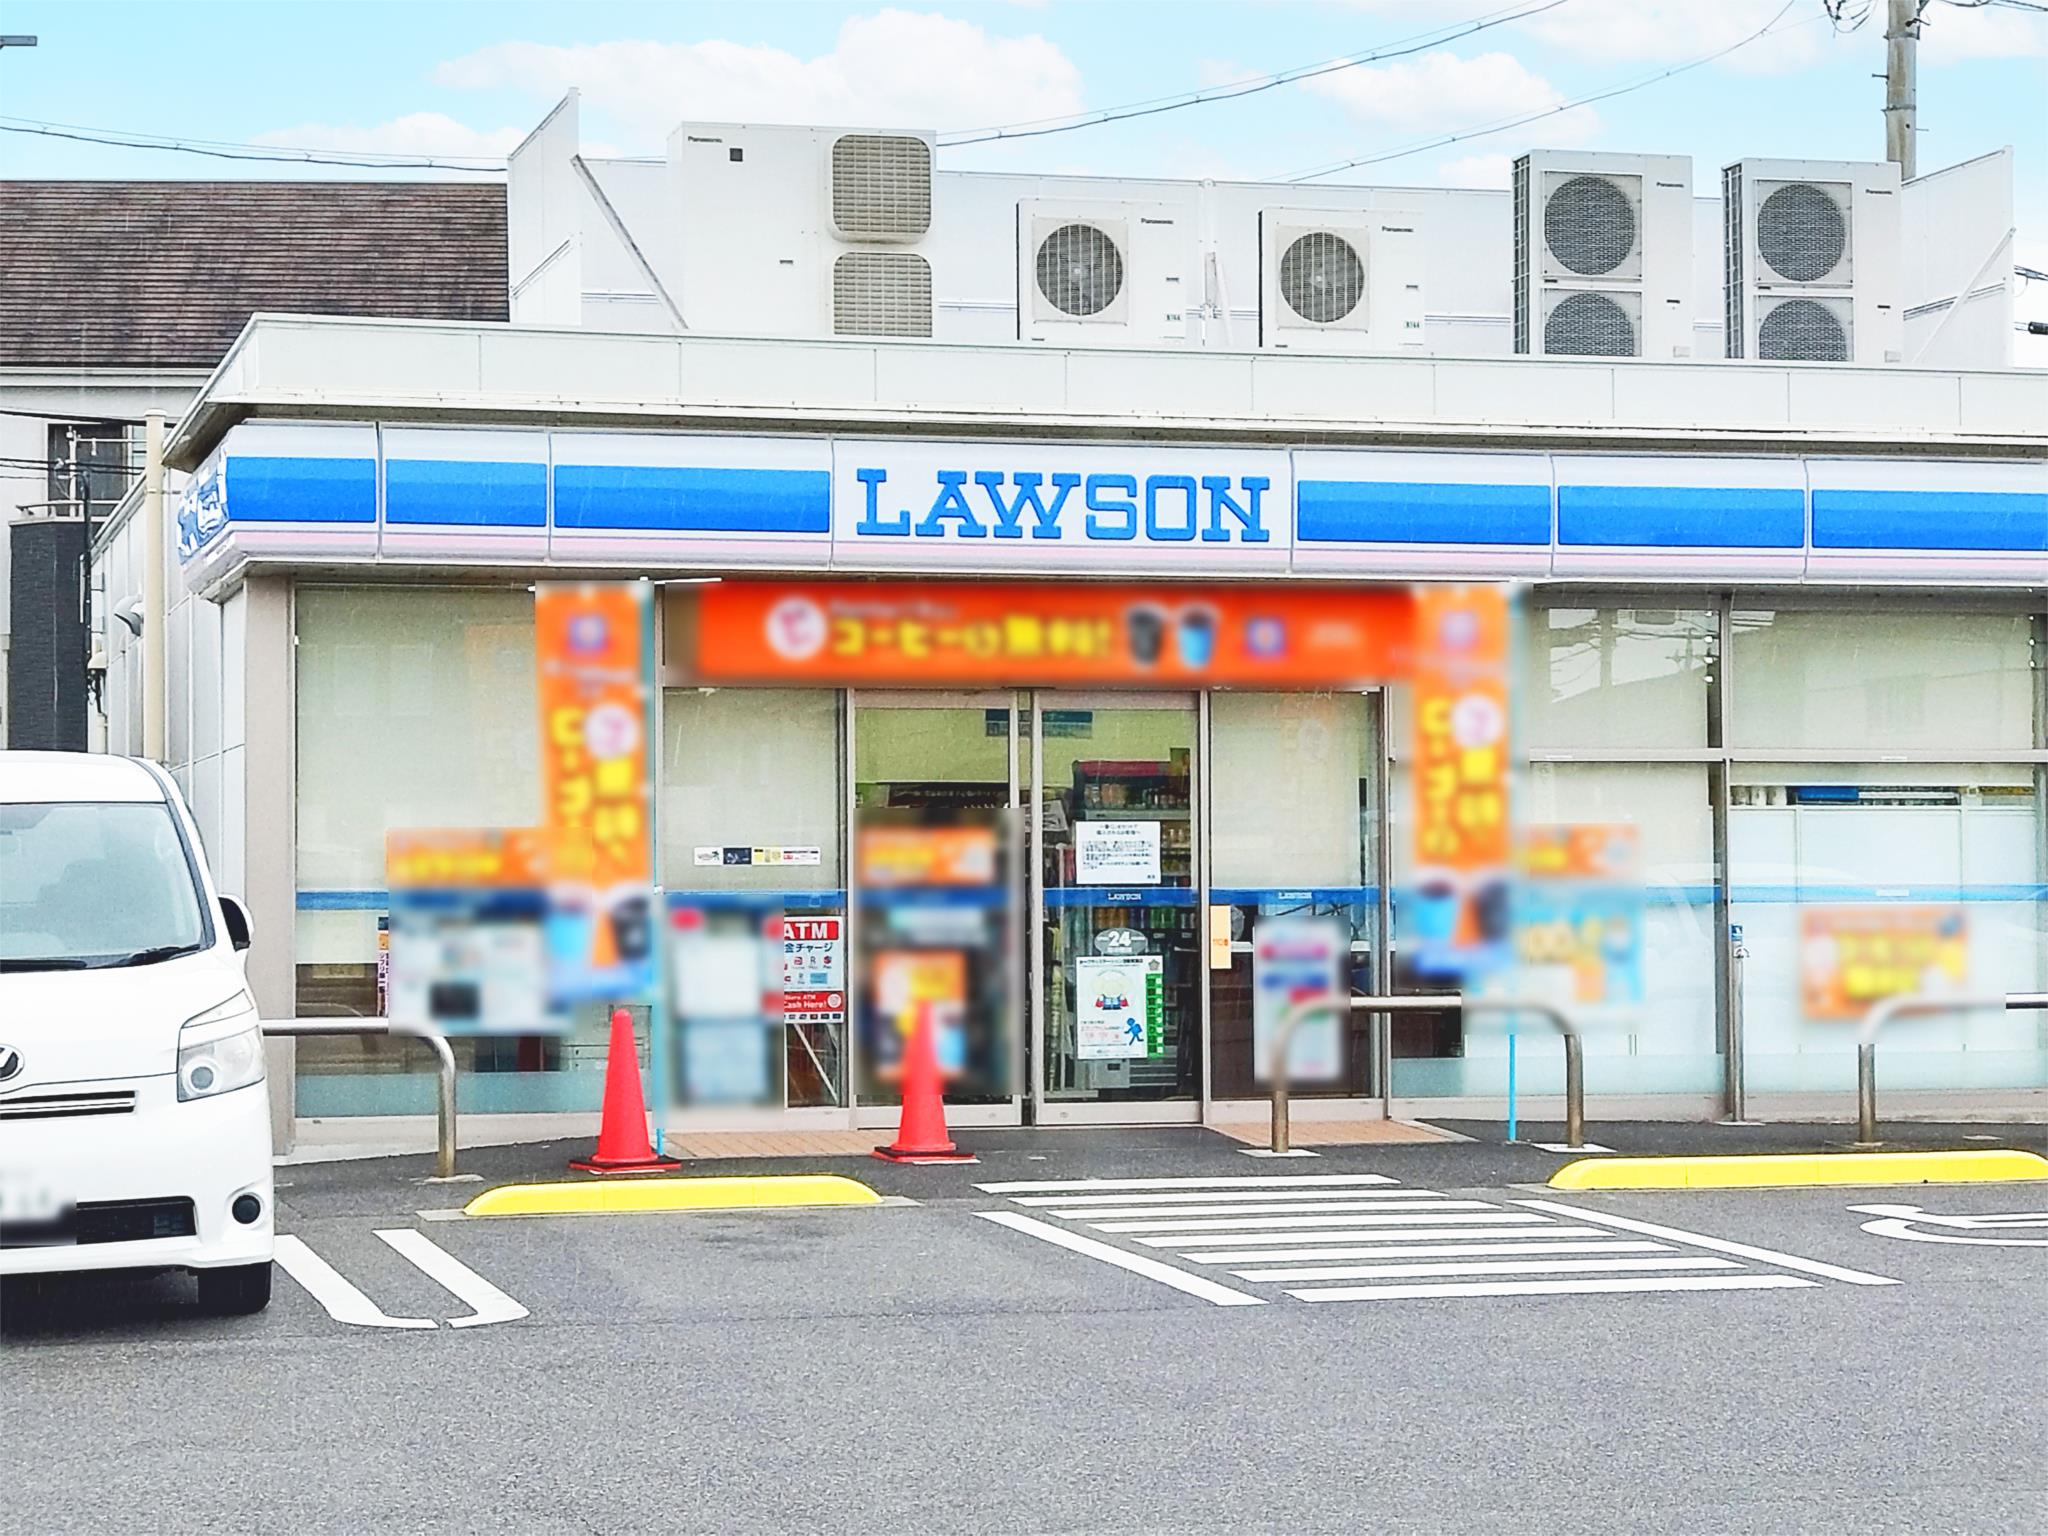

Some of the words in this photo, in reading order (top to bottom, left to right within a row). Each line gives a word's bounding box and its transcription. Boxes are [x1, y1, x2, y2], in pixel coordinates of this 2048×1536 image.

[856, 467, 1270, 543] LAWSON
[784, 922, 827, 940] ATM
[1108, 930, 1132, 947] 24
